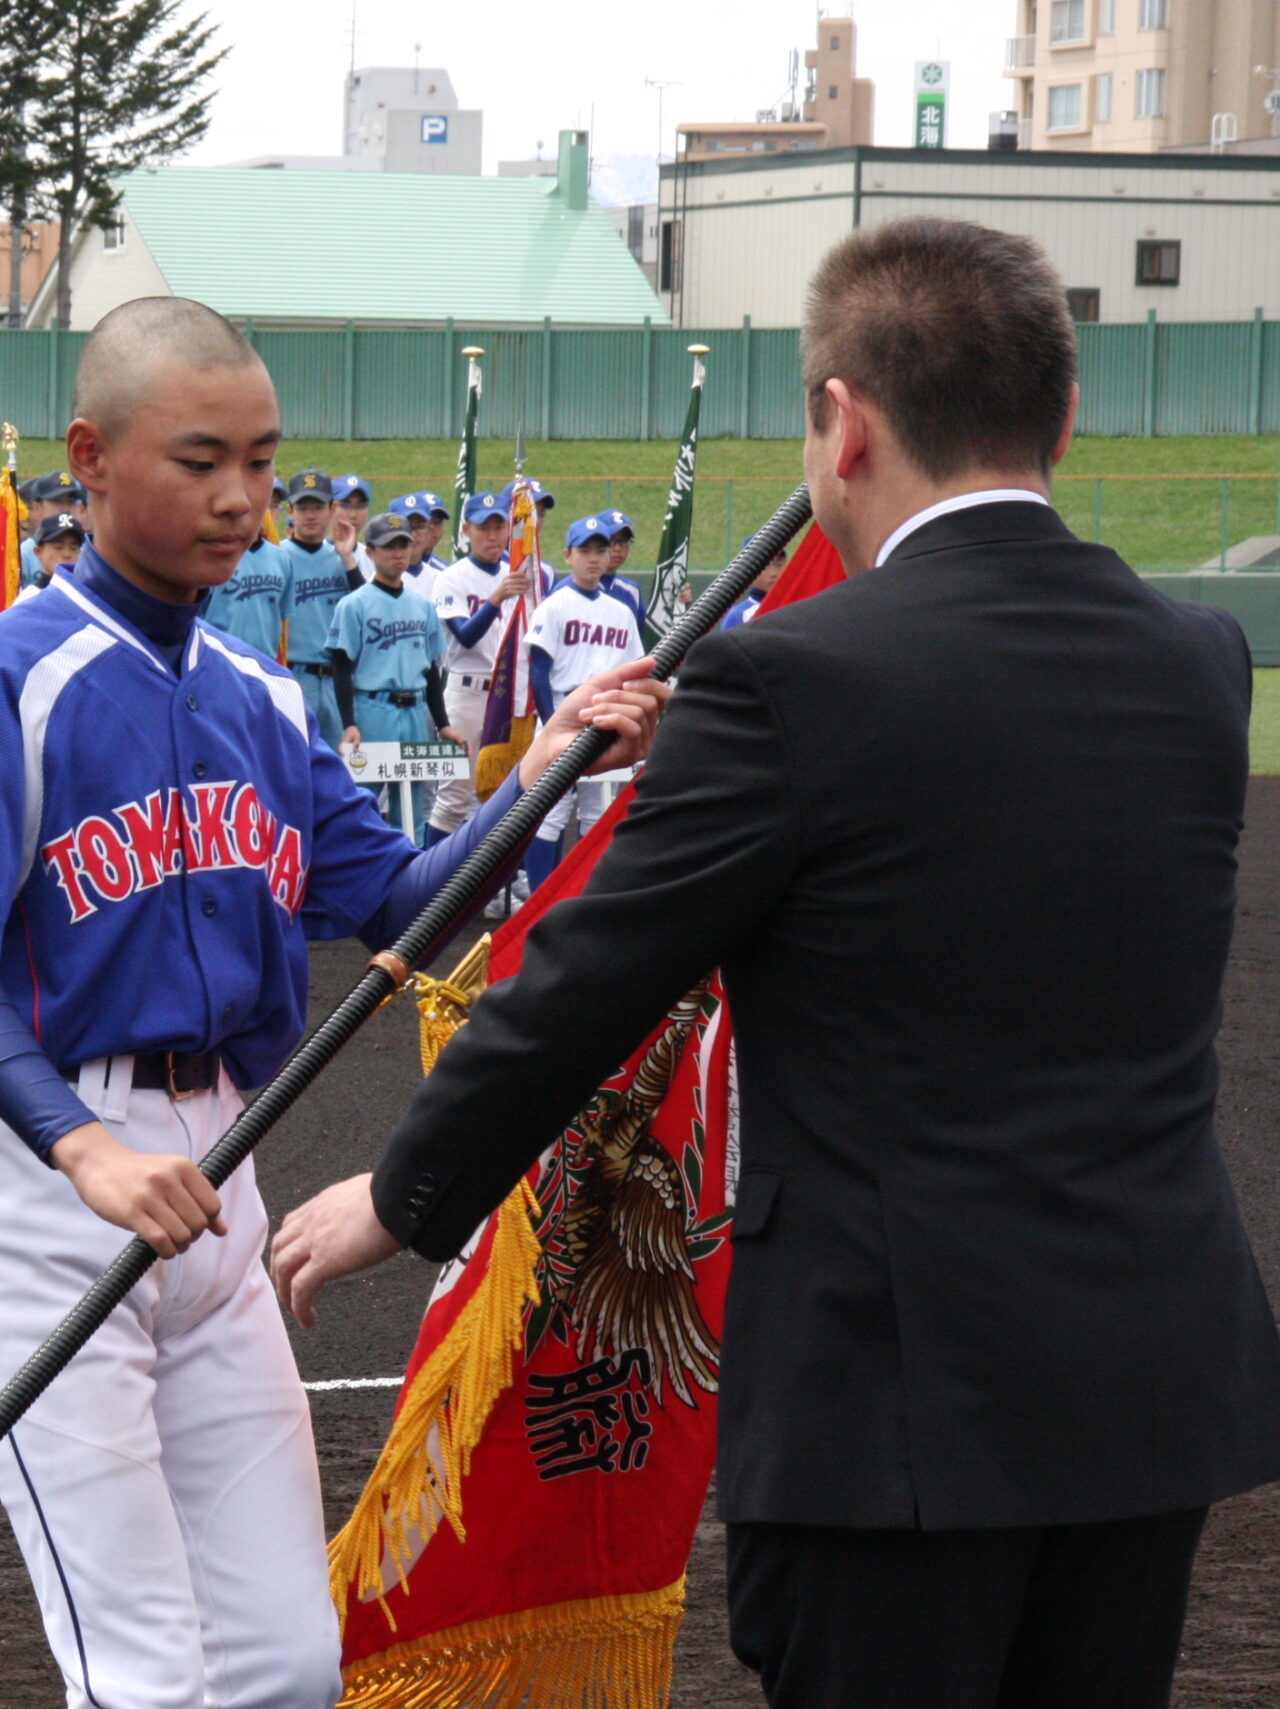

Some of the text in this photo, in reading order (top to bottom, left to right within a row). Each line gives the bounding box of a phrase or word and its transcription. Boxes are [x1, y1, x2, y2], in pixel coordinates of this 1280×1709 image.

[423, 118, 445, 141] P
[920, 105, 940, 148] 北海
[564, 620, 628, 649] OTARU
[378, 761, 456, 779] 札幌新琴似
